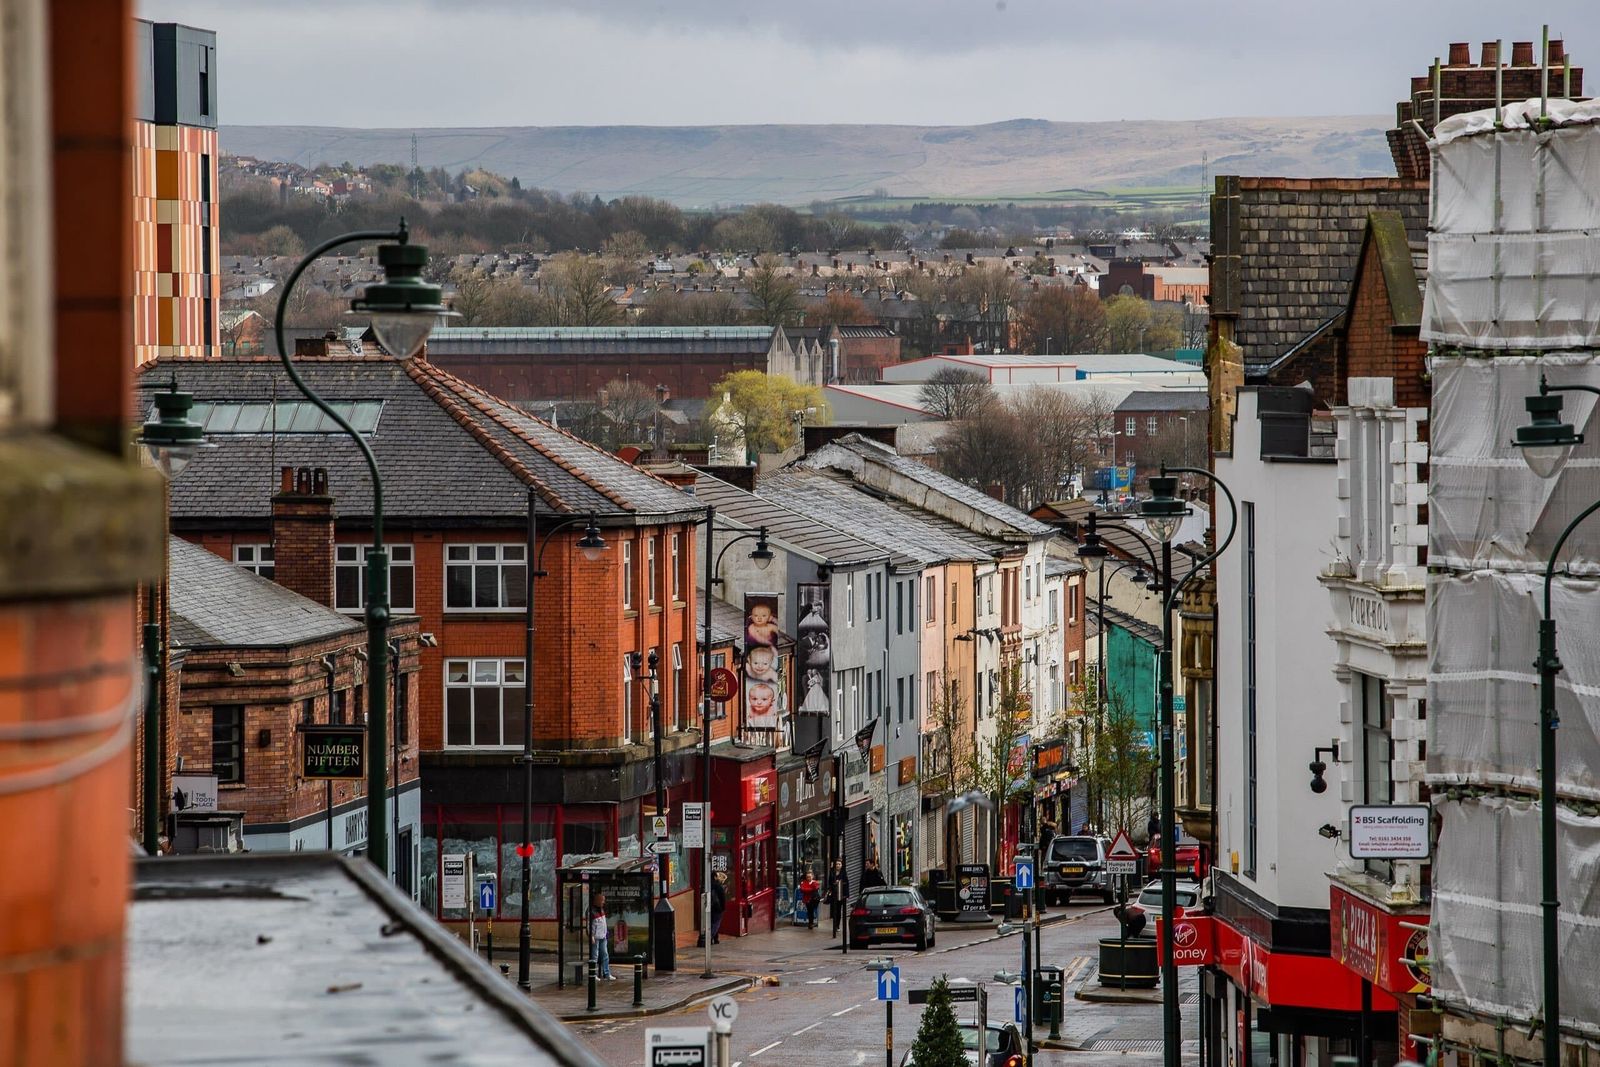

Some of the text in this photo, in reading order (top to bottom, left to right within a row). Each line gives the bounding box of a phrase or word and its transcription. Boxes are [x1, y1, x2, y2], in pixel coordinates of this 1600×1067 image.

[307, 744, 360, 755] NUMBER
[307, 756, 360, 767] FIFTEEN
[1362, 816, 1424, 826] BSI Scaffolding
[1174, 925, 1195, 944] Virgin
[1350, 903, 1369, 952] PIZZA
[1371, 914, 1377, 956] &
[712, 1002, 732, 1019] YC
